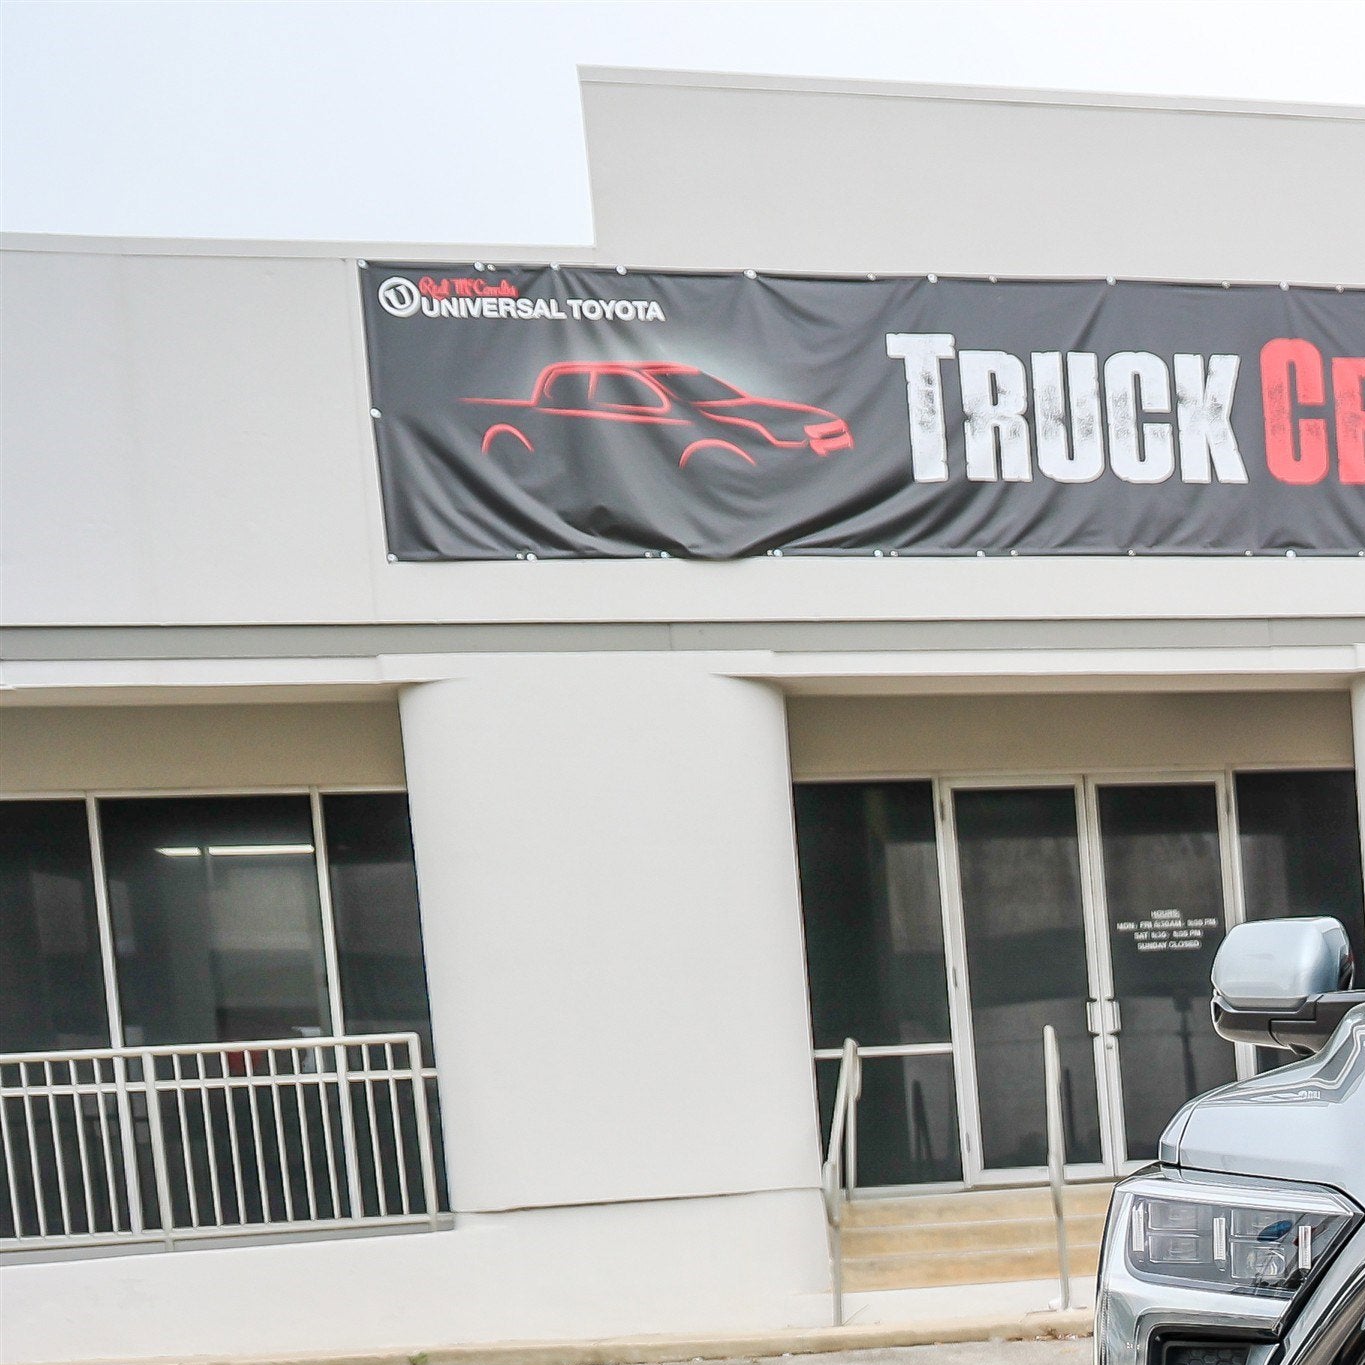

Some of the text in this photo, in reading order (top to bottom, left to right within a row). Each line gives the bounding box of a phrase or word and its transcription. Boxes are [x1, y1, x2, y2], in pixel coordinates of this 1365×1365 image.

[421, 297, 666, 322] UNIVERSAL TOYOTA
[885, 332, 1250, 486] TRUCK
